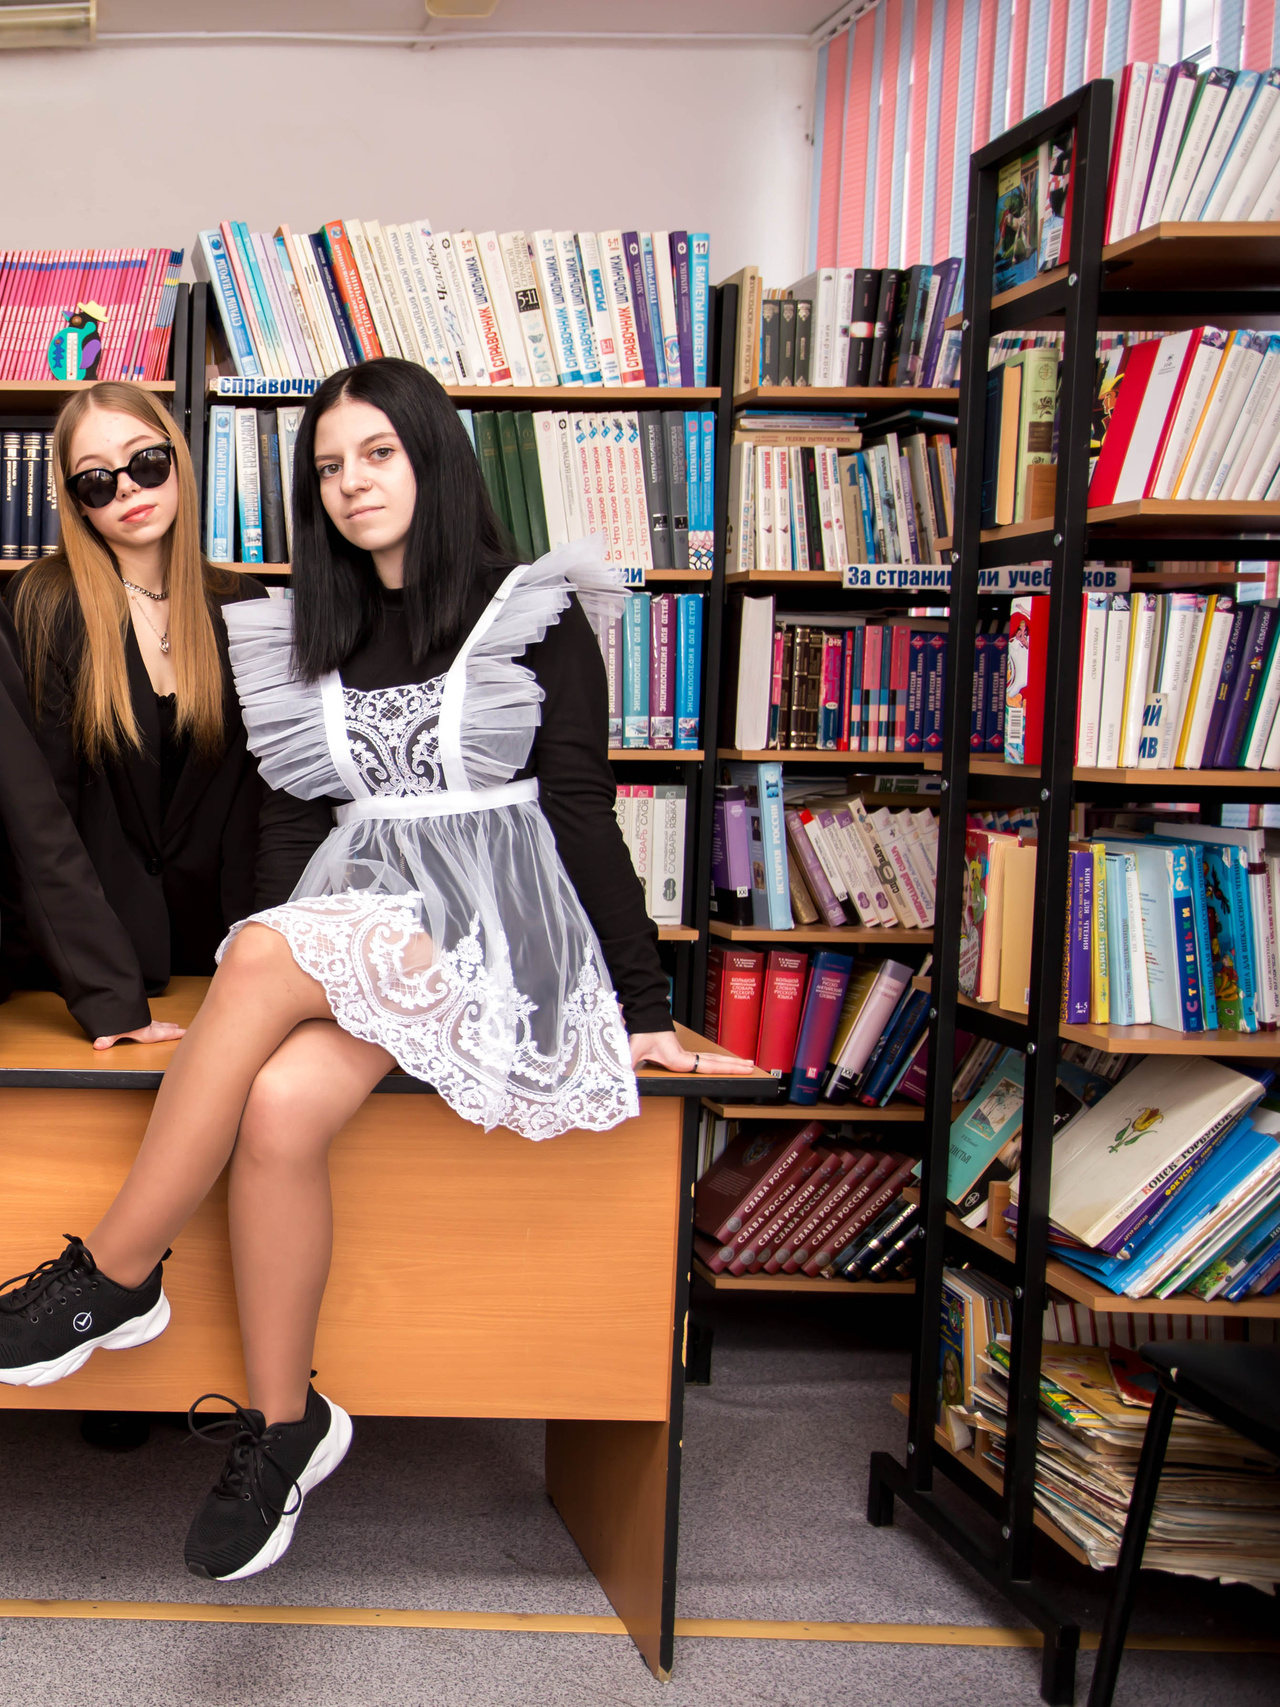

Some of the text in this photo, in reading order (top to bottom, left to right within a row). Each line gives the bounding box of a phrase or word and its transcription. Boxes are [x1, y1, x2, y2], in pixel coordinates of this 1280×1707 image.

[608, 238, 619, 247] 5-11
[696, 243, 707, 253] 11
[216, 258, 242, 327] СТРАНЫ НАРОДЫ
[334, 244, 363, 325] ИЛЛЮСТРИРОВАННЫЙ
[390, 232, 431, 350] ЭНЦИКЛОПЕДИЯ ЖИВОЙ ПРИРОДЫ
[405, 232, 445, 350] ЭНЦИКЛОПЕДИЯ ЖИВОЙ ПРИРОДЫ
[426, 239, 448, 301] Человек
[588, 268, 607, 312] РУССКИЙ
[610, 255, 629, 305] ШКОЛЬНИКА
[633, 262, 644, 295] ХИМИКА
[644, 254, 658, 304] ГЕОГРАФИЯ
[679, 262, 688, 294] ХИМИКА
[696, 265, 706, 315] БИЛЕТЫ
[349, 268, 372, 335] СПРАВОЧНИК
[465, 255, 505, 368] СПРАВОЧНИК ШКОЛЬНИКА
[517, 290, 539, 308] 5-11
[546, 255, 577, 369] СПРАВОЧНИК ШКОЛЬНИКА
[566, 255, 597, 370] СПРАВОЧНИК ШКОЛЬНИКА
[618, 306, 639, 369] СПРАВОЧНИК
[694, 324, 705, 367] ОТВЕТЫ
[220, 378, 320, 396] справочн
[215, 437, 227, 506] СТРАНЫ И НАРОДЫ
[606, 445, 614, 474] такой
[648, 424, 656, 484] МАТЕМАТИЧЕСКАЯ
[703, 435, 711, 483] МАТЕМАТИКА
[846, 463, 858, 486] 1
[608, 474, 616, 493] Кто
[621, 475, 630, 494] Кто
[632, 447, 648, 547] Что такое Кто такой
[587, 497, 595, 525] такое
[613, 527, 621, 545] Что
[623, 497, 632, 525] такое
[605, 550, 611, 561] 3
[615, 550, 623, 561] 3
[626, 528, 634, 546] Что
[630, 551, 635, 561] 1
[643, 551, 649, 561] 1
[848, 566, 1116, 587] За страними учебков
[633, 646, 641, 712] ЭНЦИКЛОПЕДИЯ
[660, 599, 669, 712] ЭНЦИКЛОПЕДИЯ ДЛЯ ДЕТЕЙ
[687, 648, 695, 713] ЭНЦИКЛОПЕДИЯ
[1172, 662, 1180, 691] ВСАДНИК
[639, 799, 649, 873] СЛОВАРЬ СЛОВ
[668, 830, 676, 874] СЛОВАРЬ
[771, 804, 785, 895] ИСТОРИЯ РОССИИ
[1175, 877, 1184, 891] 6
[1180, 857, 1187, 871] 5
[1233, 858, 1241, 890] ЧТЕНИЯ
[1097, 879, 1107, 977] ЛЬЮИС КЭРРОЛЛ
[1201, 894, 1211, 951] ВНЕКЛАССНОГО
[1238, 890, 1250, 954] ВНЕКЛАССНОГО
[1182, 907, 1198, 1012] СТУПЕНЬКИ
[1075, 1002, 1088, 1010] 4-5
[744, 1151, 798, 1213] СЛАВА РОССИИ
[1165, 1166, 1193, 1196] ФОКУСЫ
[737, 1184, 796, 1243] СЛАВА РОССИИ
[758, 1185, 815, 1246] СЛАВА РОССИИ
[774, 1183, 830, 1244] СЛАВА РОССИИ
[794, 1184, 850, 1245] СЛАВА РОССИИ
[812, 1185, 870, 1245] СЛАВА РОССИИ
[834, 1222, 861, 1248] СЛАВА
[861, 1189, 893, 1222] РОССИИ
